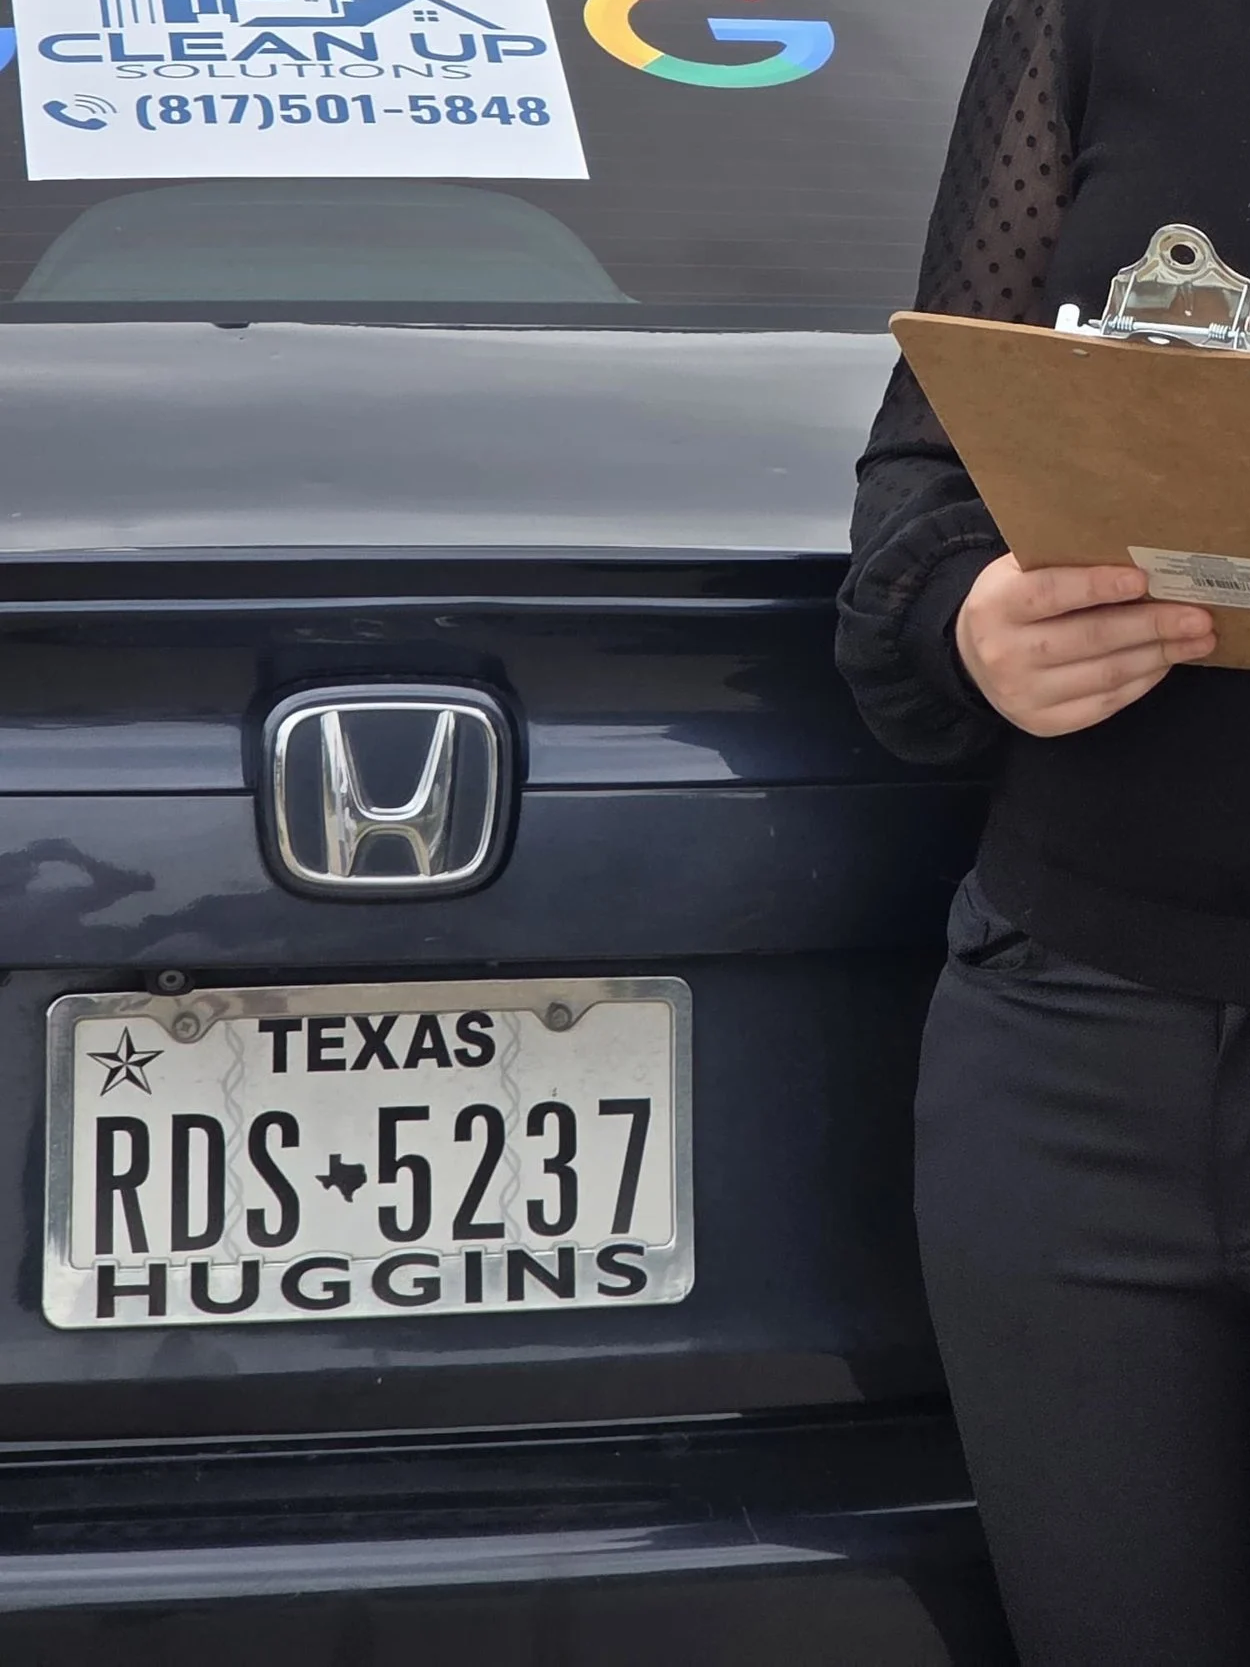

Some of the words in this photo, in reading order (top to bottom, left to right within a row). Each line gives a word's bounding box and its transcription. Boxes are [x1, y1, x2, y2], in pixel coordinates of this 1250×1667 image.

[38, 31, 379, 62] CLEAN
[411, 32, 548, 63] UP
[115, 63, 473, 80] SOLUTIONS
[135, 93, 551, 130] (817)501-5848
[258, 1010, 496, 1073] TEXAS
[95, 1110, 301, 1255] RDS
[377, 1097, 652, 1244] 5237
[95, 1244, 648, 1319] HUGGINS
